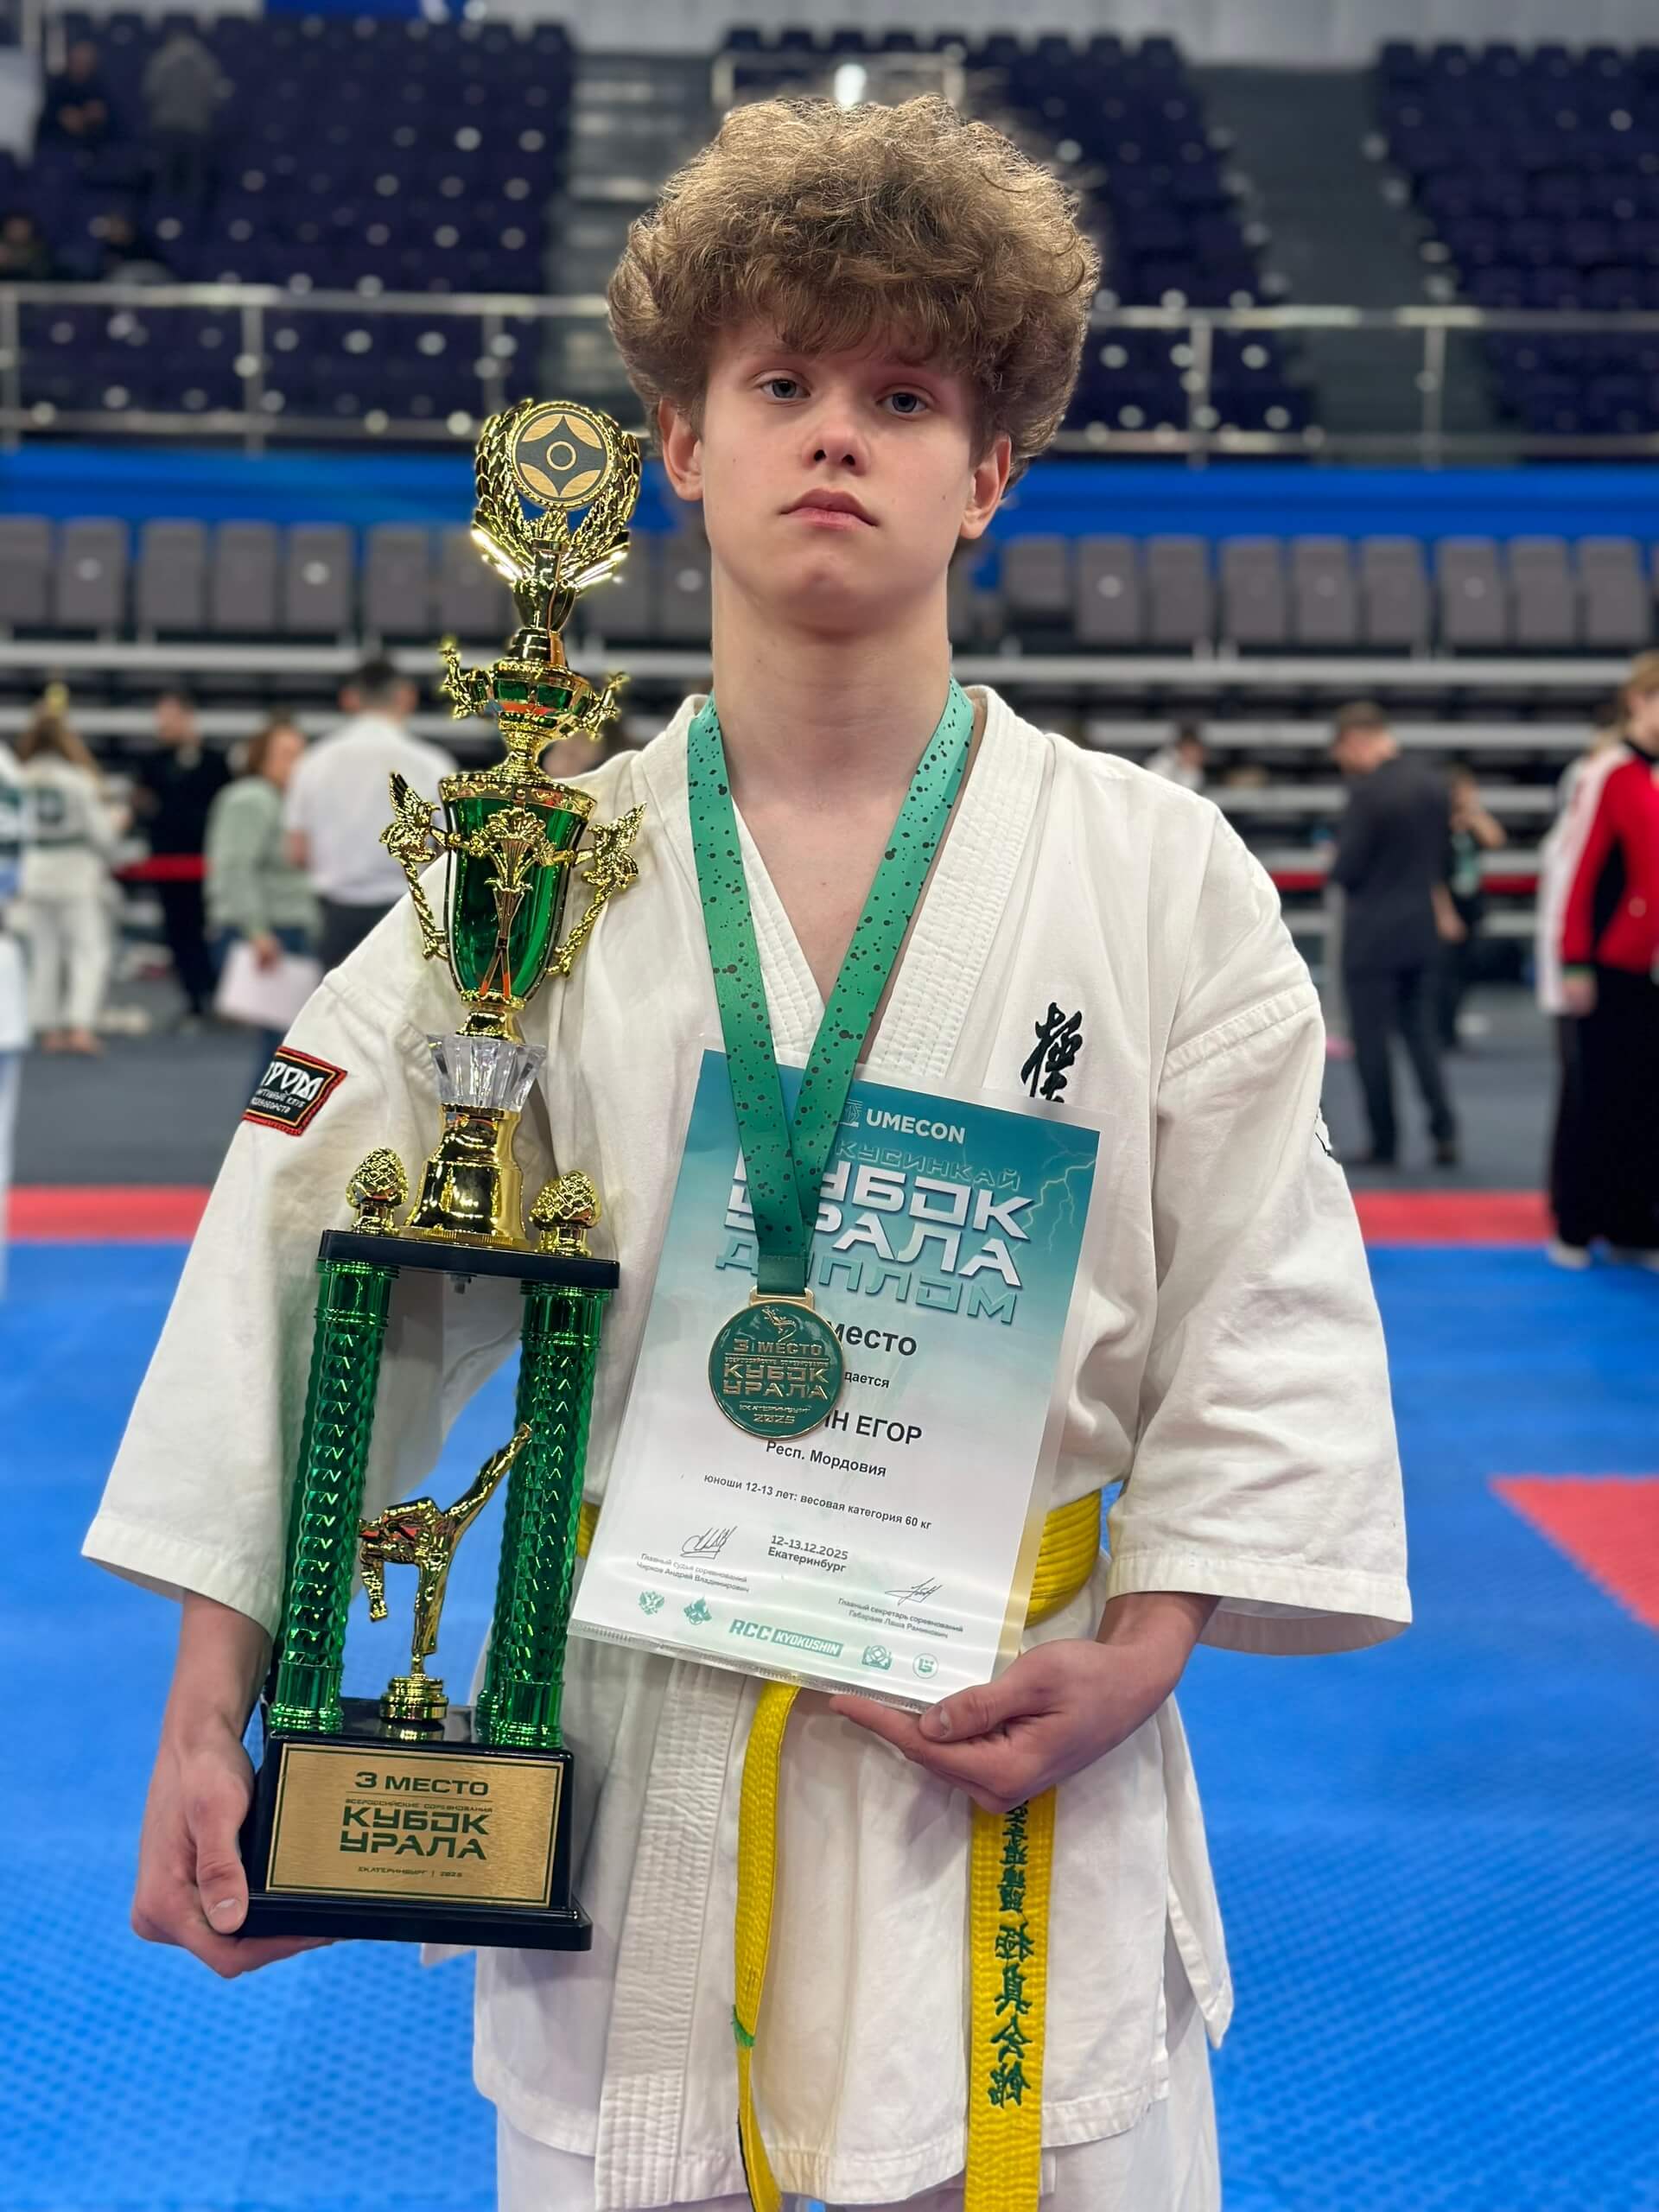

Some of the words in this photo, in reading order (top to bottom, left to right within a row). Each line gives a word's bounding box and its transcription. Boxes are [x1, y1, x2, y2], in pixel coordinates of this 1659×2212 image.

[865, 1108, 966, 1145] UMECON
[836, 1139, 1021, 1192] КУСИНКАЙ
[715, 1236, 1018, 1325] ДПЛОМ
[757, 1340, 823, 1356] МЕСТО
[723, 1363, 830, 1383] КУБОК
[843, 1371, 890, 1389] дается
[722, 1379, 829, 1401] УРАЛА
[855, 1414, 923, 1445] ЕГОР
[766, 1440, 805, 1460] Респ.
[810, 1449, 887, 1478] Мордовия
[703, 1474, 742, 1490] юноши
[746, 1482, 773, 1496] 12-13
[775, 1490, 798, 1502] лет:
[800, 1495, 846, 1512] весовая
[848, 1504, 903, 1524] категория
[905, 1516, 918, 1527] 60
[920, 1520, 932, 1530] кг
[767, 1547, 847, 1573] Екатеринбург
[770, 1535, 849, 1560] 12-13.12.2025
[728, 1618, 772, 1641] RCC
[775, 1630, 841, 1656] KYOKUSHIN
[355, 1771, 378, 1789] 3
[385, 1775, 489, 1796] МЕСТО
[342, 1806, 490, 1836] КУБОК
[339, 1830, 487, 1860] УРАЛА
